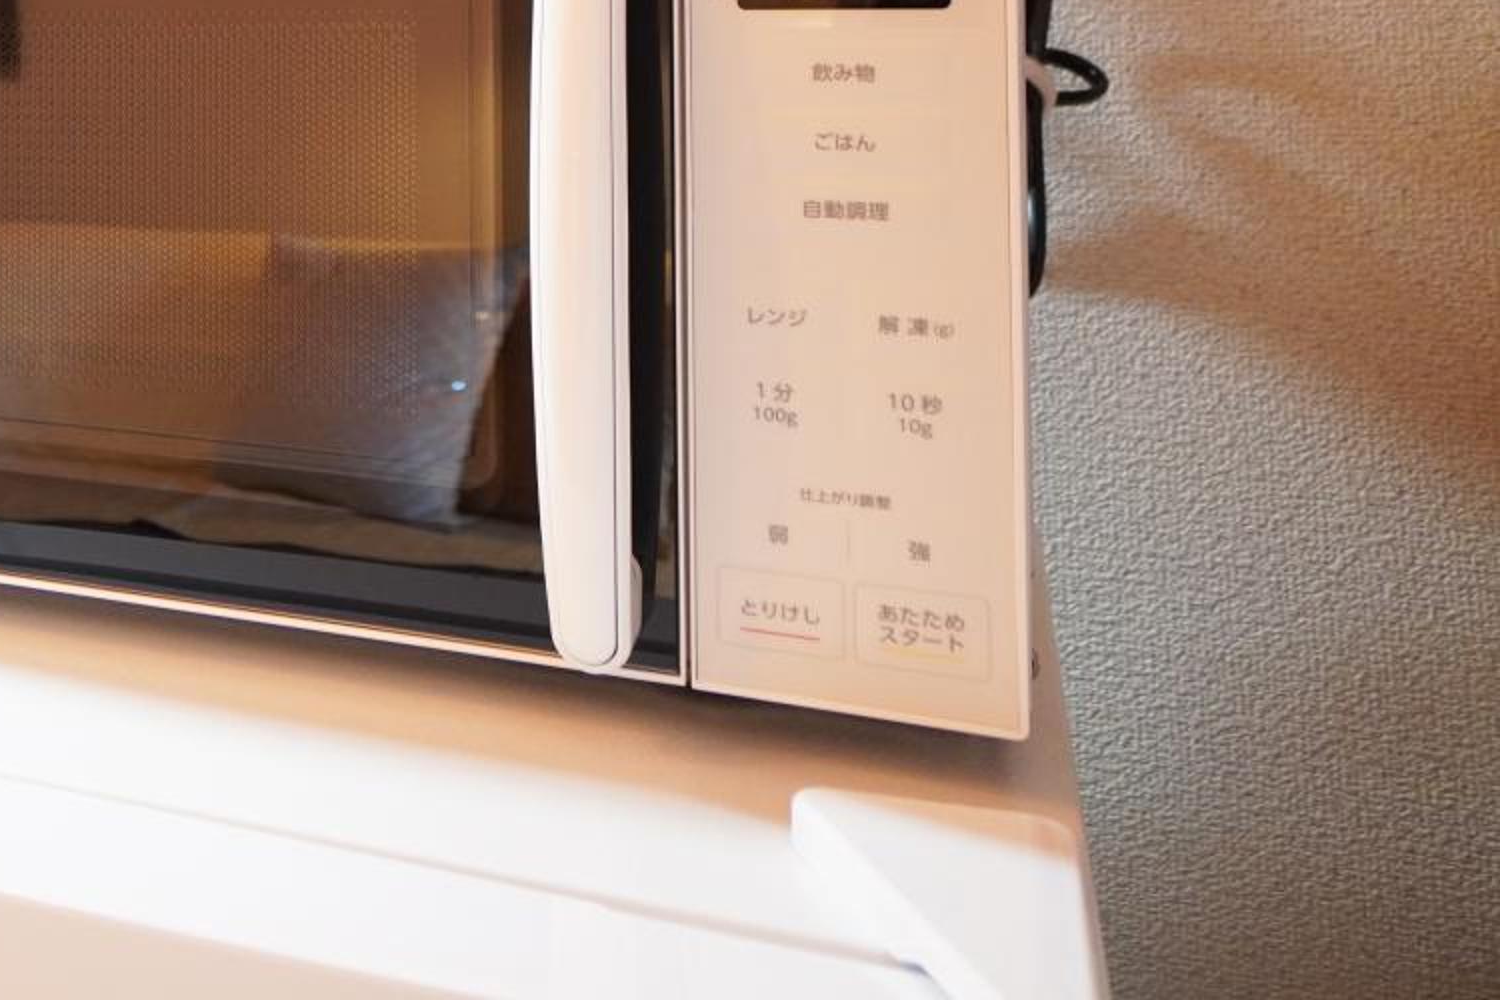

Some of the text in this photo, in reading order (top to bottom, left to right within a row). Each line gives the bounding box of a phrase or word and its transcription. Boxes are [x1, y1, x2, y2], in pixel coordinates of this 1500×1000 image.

[812, 64, 876, 83] 飲み物
[814, 133, 876, 152] ごはん
[803, 201, 890, 221] 自動調理
[747, 307, 807, 327] レンジ
[754, 406, 798, 427] 100g
[900, 418, 933, 439] 10g
[741, 600, 820, 625] とりけし
[878, 604, 965, 632] あたため
[879, 627, 965, 653] スタート
